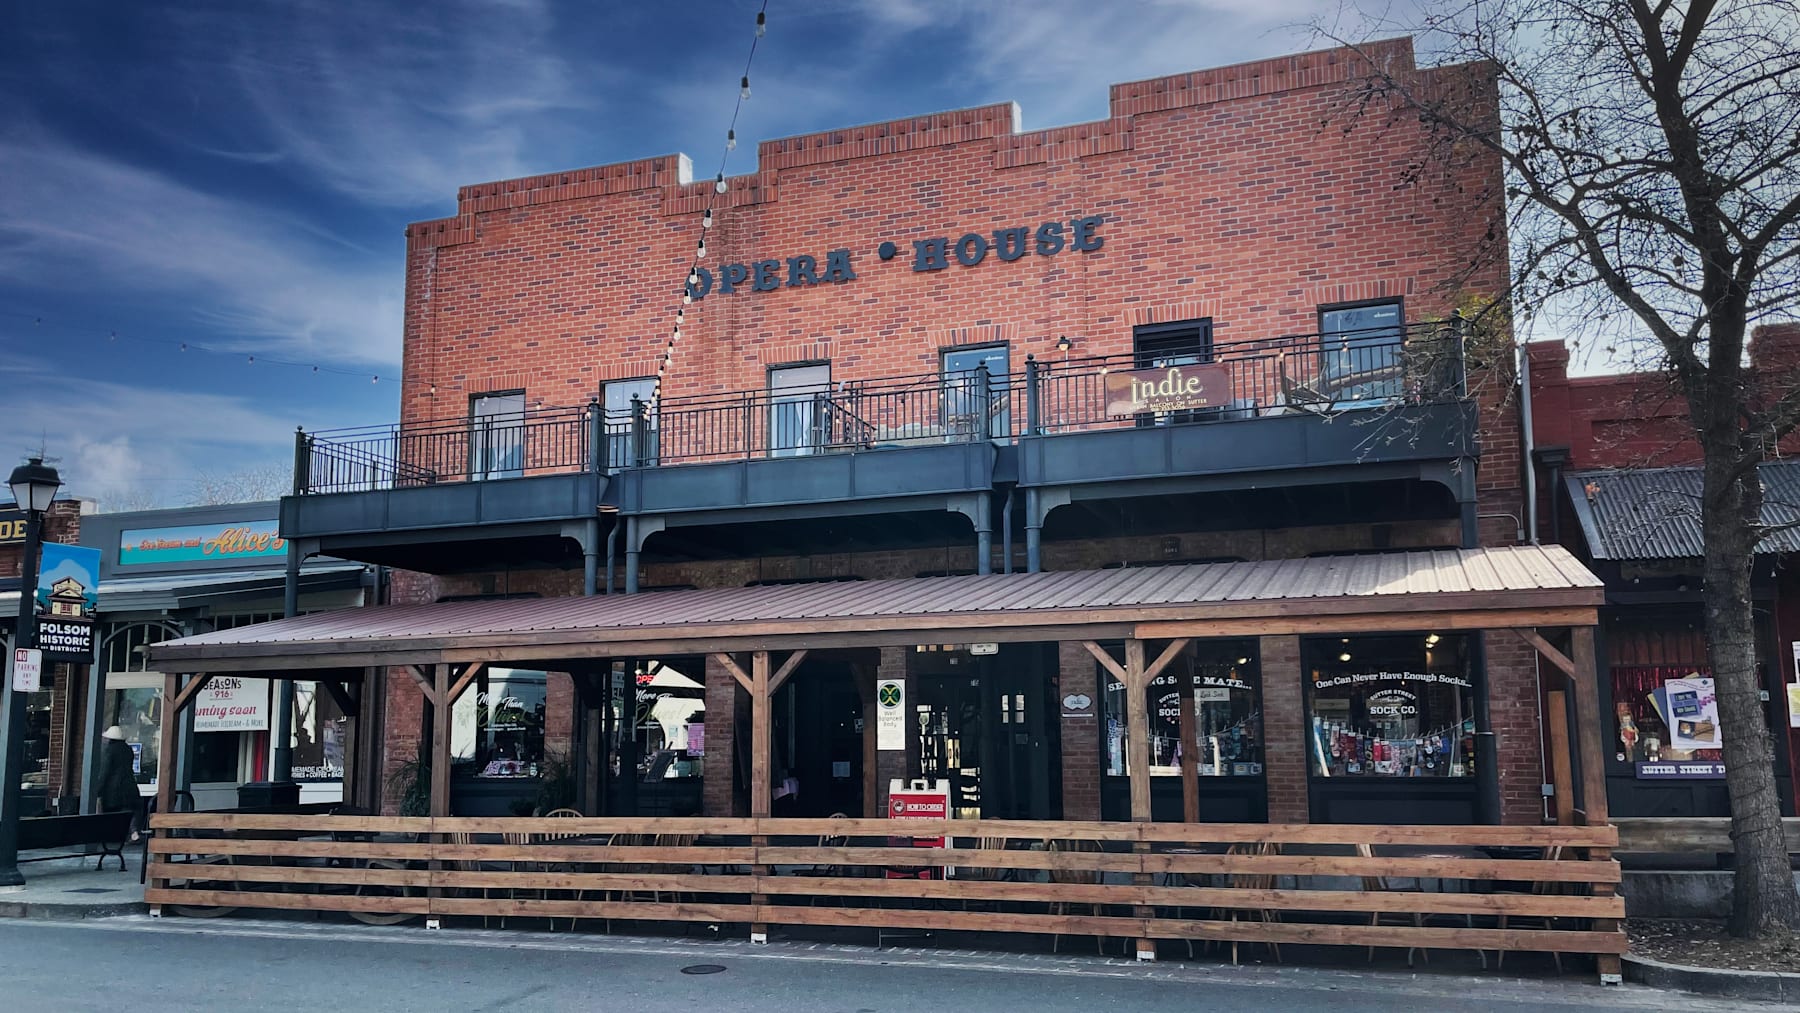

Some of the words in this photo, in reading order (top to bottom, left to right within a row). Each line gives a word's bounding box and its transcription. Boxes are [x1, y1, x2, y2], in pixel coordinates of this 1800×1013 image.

[686, 248, 857, 301] OPERA
[913, 213, 1104, 272] HOUSE
[1131, 368, 1204, 405] indie
[40, 622, 91, 636] FOLSOM
[40, 634, 90, 646] HISTORIC
[49, 645, 80, 653] DISTRICT
[17, 650, 27, 661] NO
[17, 664, 38, 672] PARKING
[636, 674, 655, 685] OPE
[1316, 679, 1333, 689] One
[1334, 676, 1351, 685] Can
[1353, 673, 1378, 682] Never
[1379, 671, 1402, 680] Have
[1403, 671, 1437, 682] Enough
[1438, 674, 1473, 688] Socks...
[214, 690, 230, 698] 916
[1370, 689, 1392, 701] SUTTER
[1393, 689, 1417, 700] STREET
[229, 706, 257, 715] soon
[1370, 706, 1400, 715] SOCK
[1400, 705, 1418, 714] CO.
[1642, 765, 1676, 774] SUTTER
[1680, 765, 1713, 774] STREET
